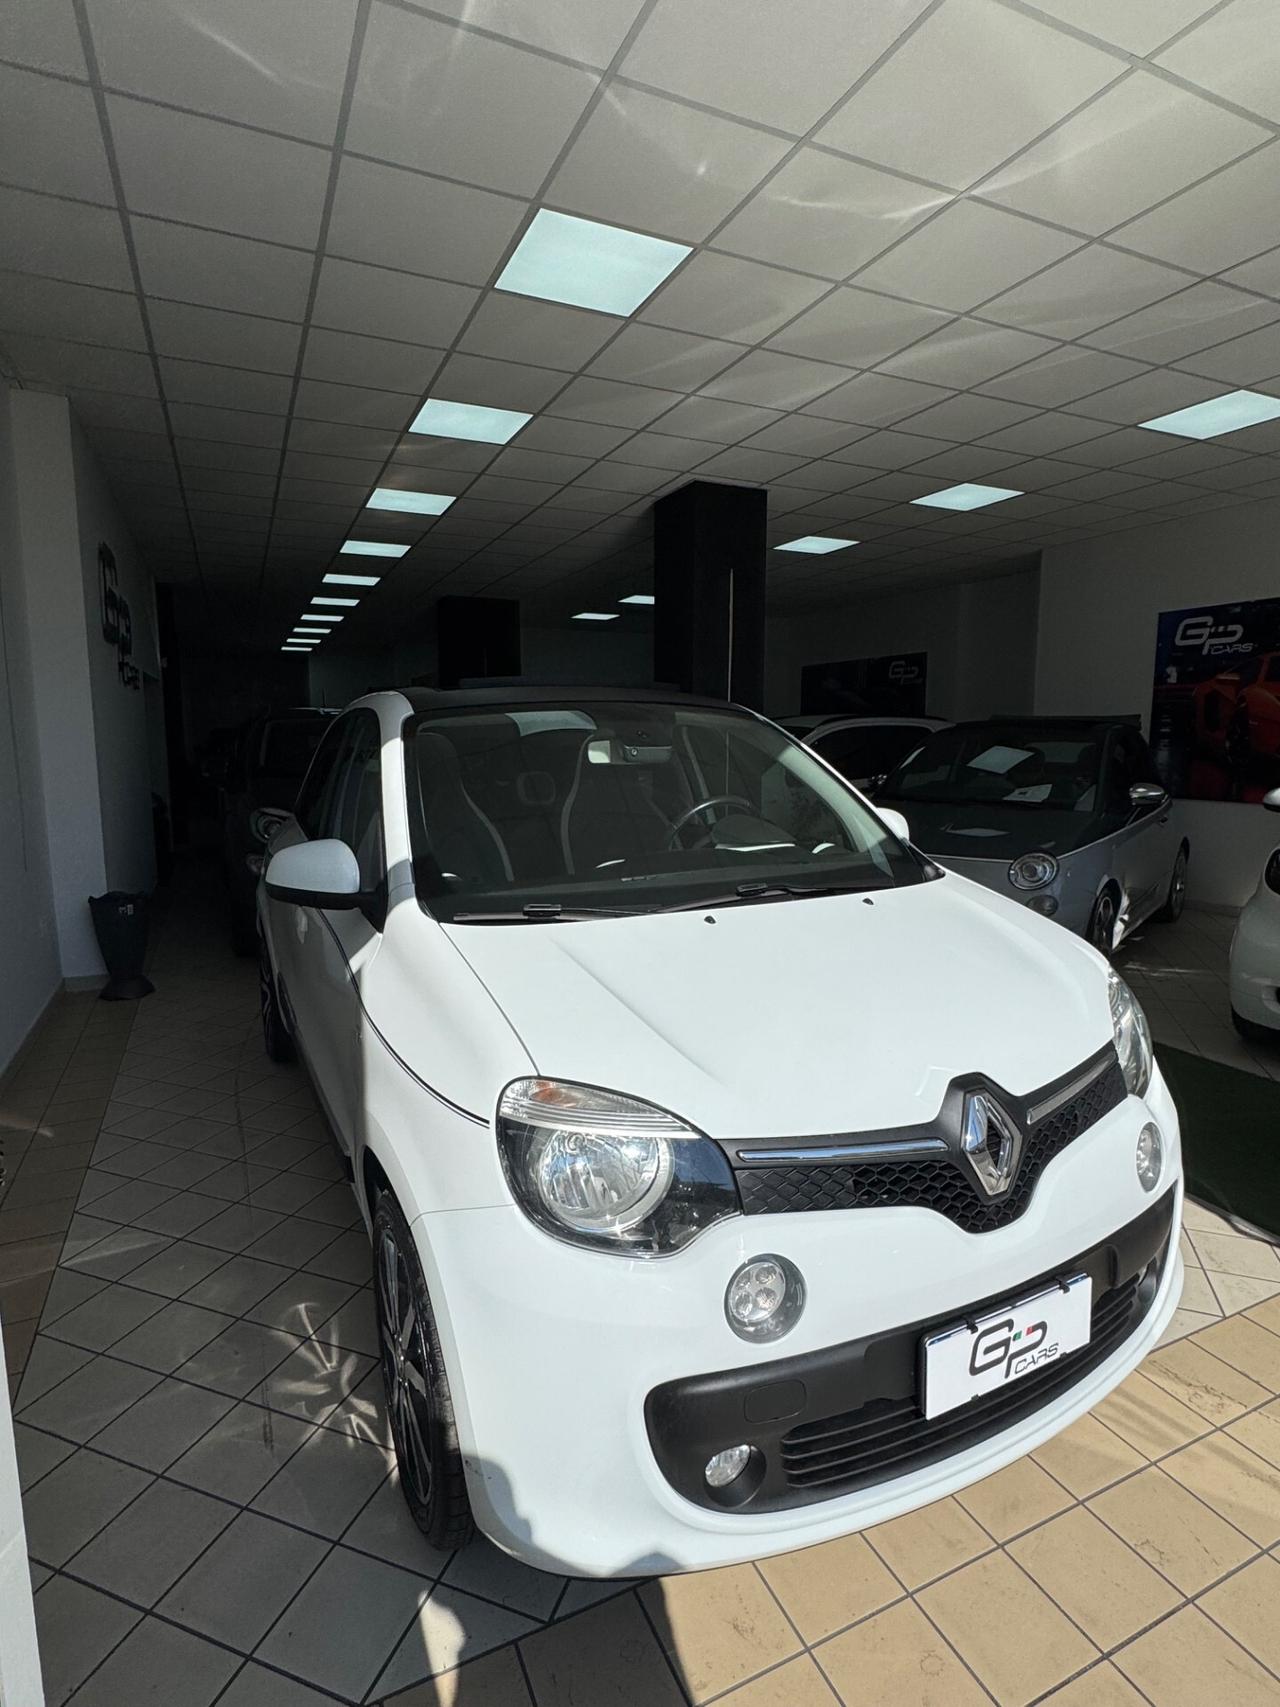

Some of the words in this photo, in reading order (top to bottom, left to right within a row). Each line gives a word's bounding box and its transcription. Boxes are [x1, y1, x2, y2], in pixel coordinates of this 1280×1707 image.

[1174, 615, 1244, 656] GP
[1210, 642, 1254, 655] CARS
[969, 1318, 1047, 1379] GP
[1014, 1342, 1059, 1375] CARS
